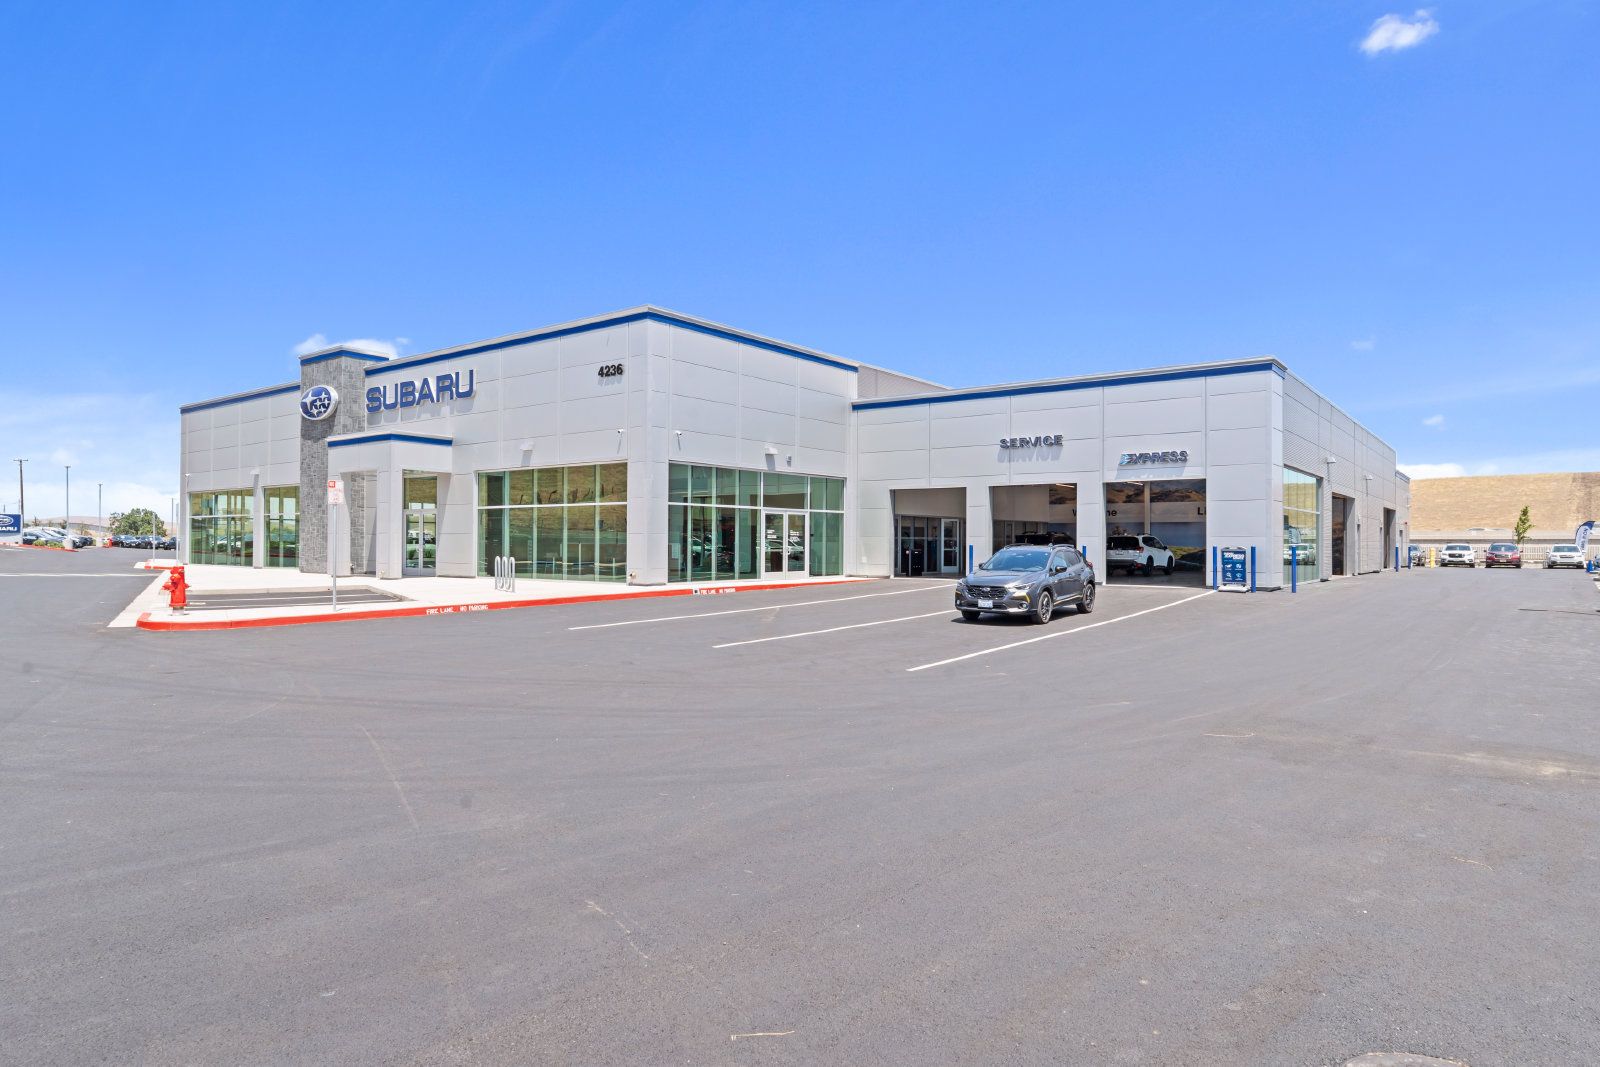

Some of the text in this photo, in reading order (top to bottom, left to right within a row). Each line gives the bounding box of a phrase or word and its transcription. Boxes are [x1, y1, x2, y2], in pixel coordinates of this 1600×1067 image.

[598, 363, 623, 378] 4236
[366, 369, 474, 413] SUBARU
[999, 434, 1062, 448] SERVICE
[1119, 450, 1188, 465] EXPRESS
